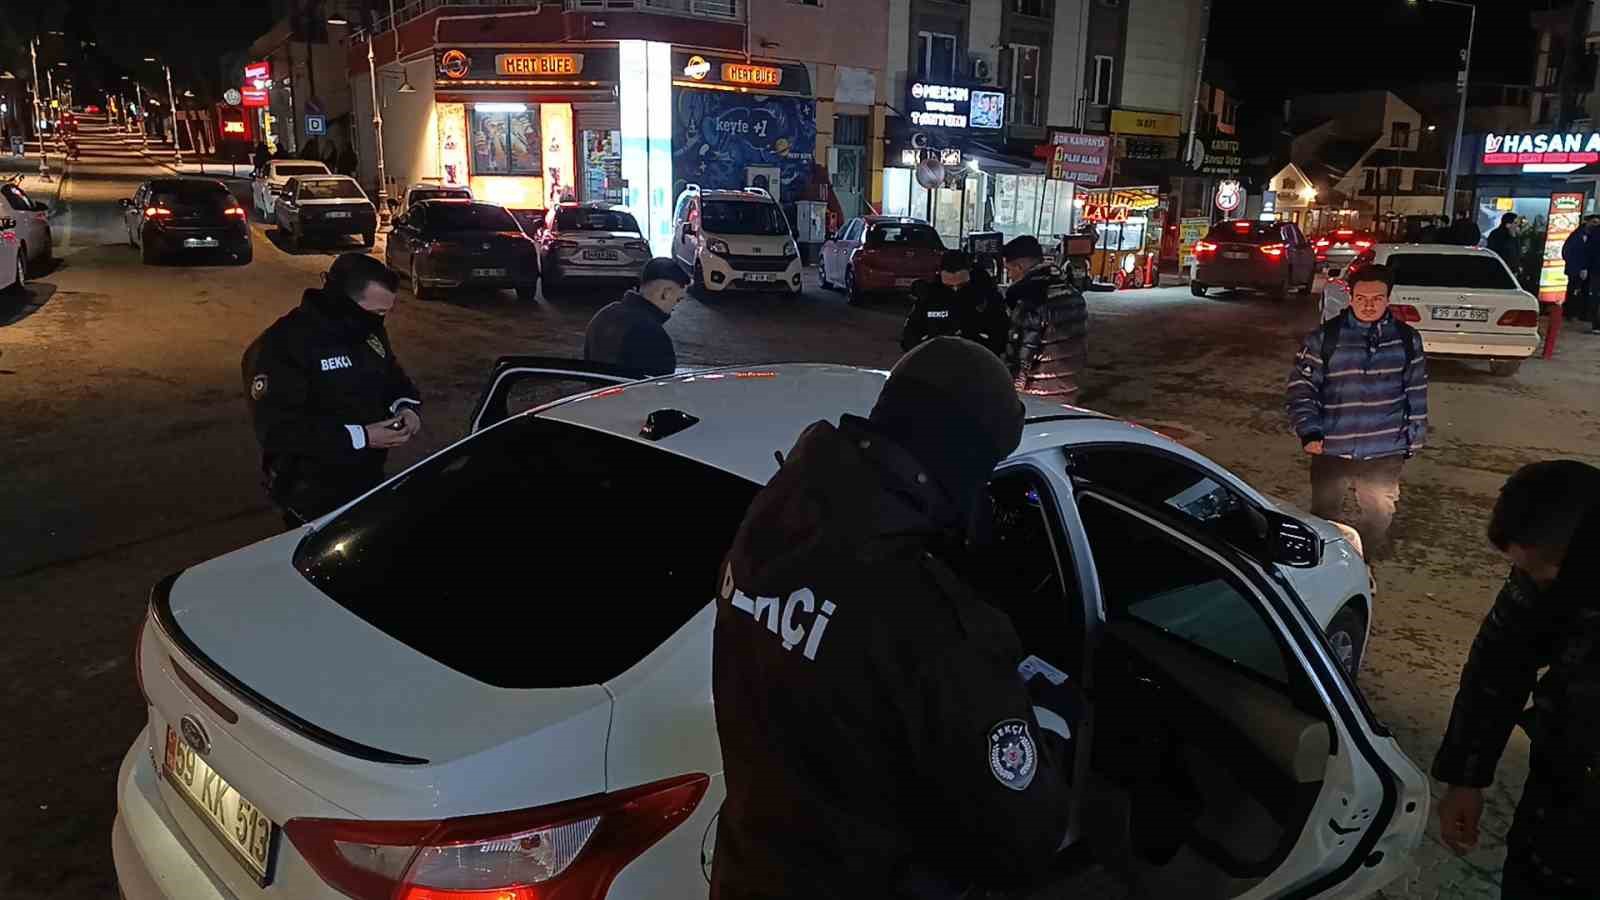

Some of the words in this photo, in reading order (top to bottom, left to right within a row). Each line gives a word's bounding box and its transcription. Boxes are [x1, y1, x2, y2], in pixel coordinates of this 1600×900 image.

[506, 58, 536, 73] MERT
[1502, 132, 1583, 153] HASAN
[202, 767, 230, 826] KK
[235, 798, 270, 863] 513
